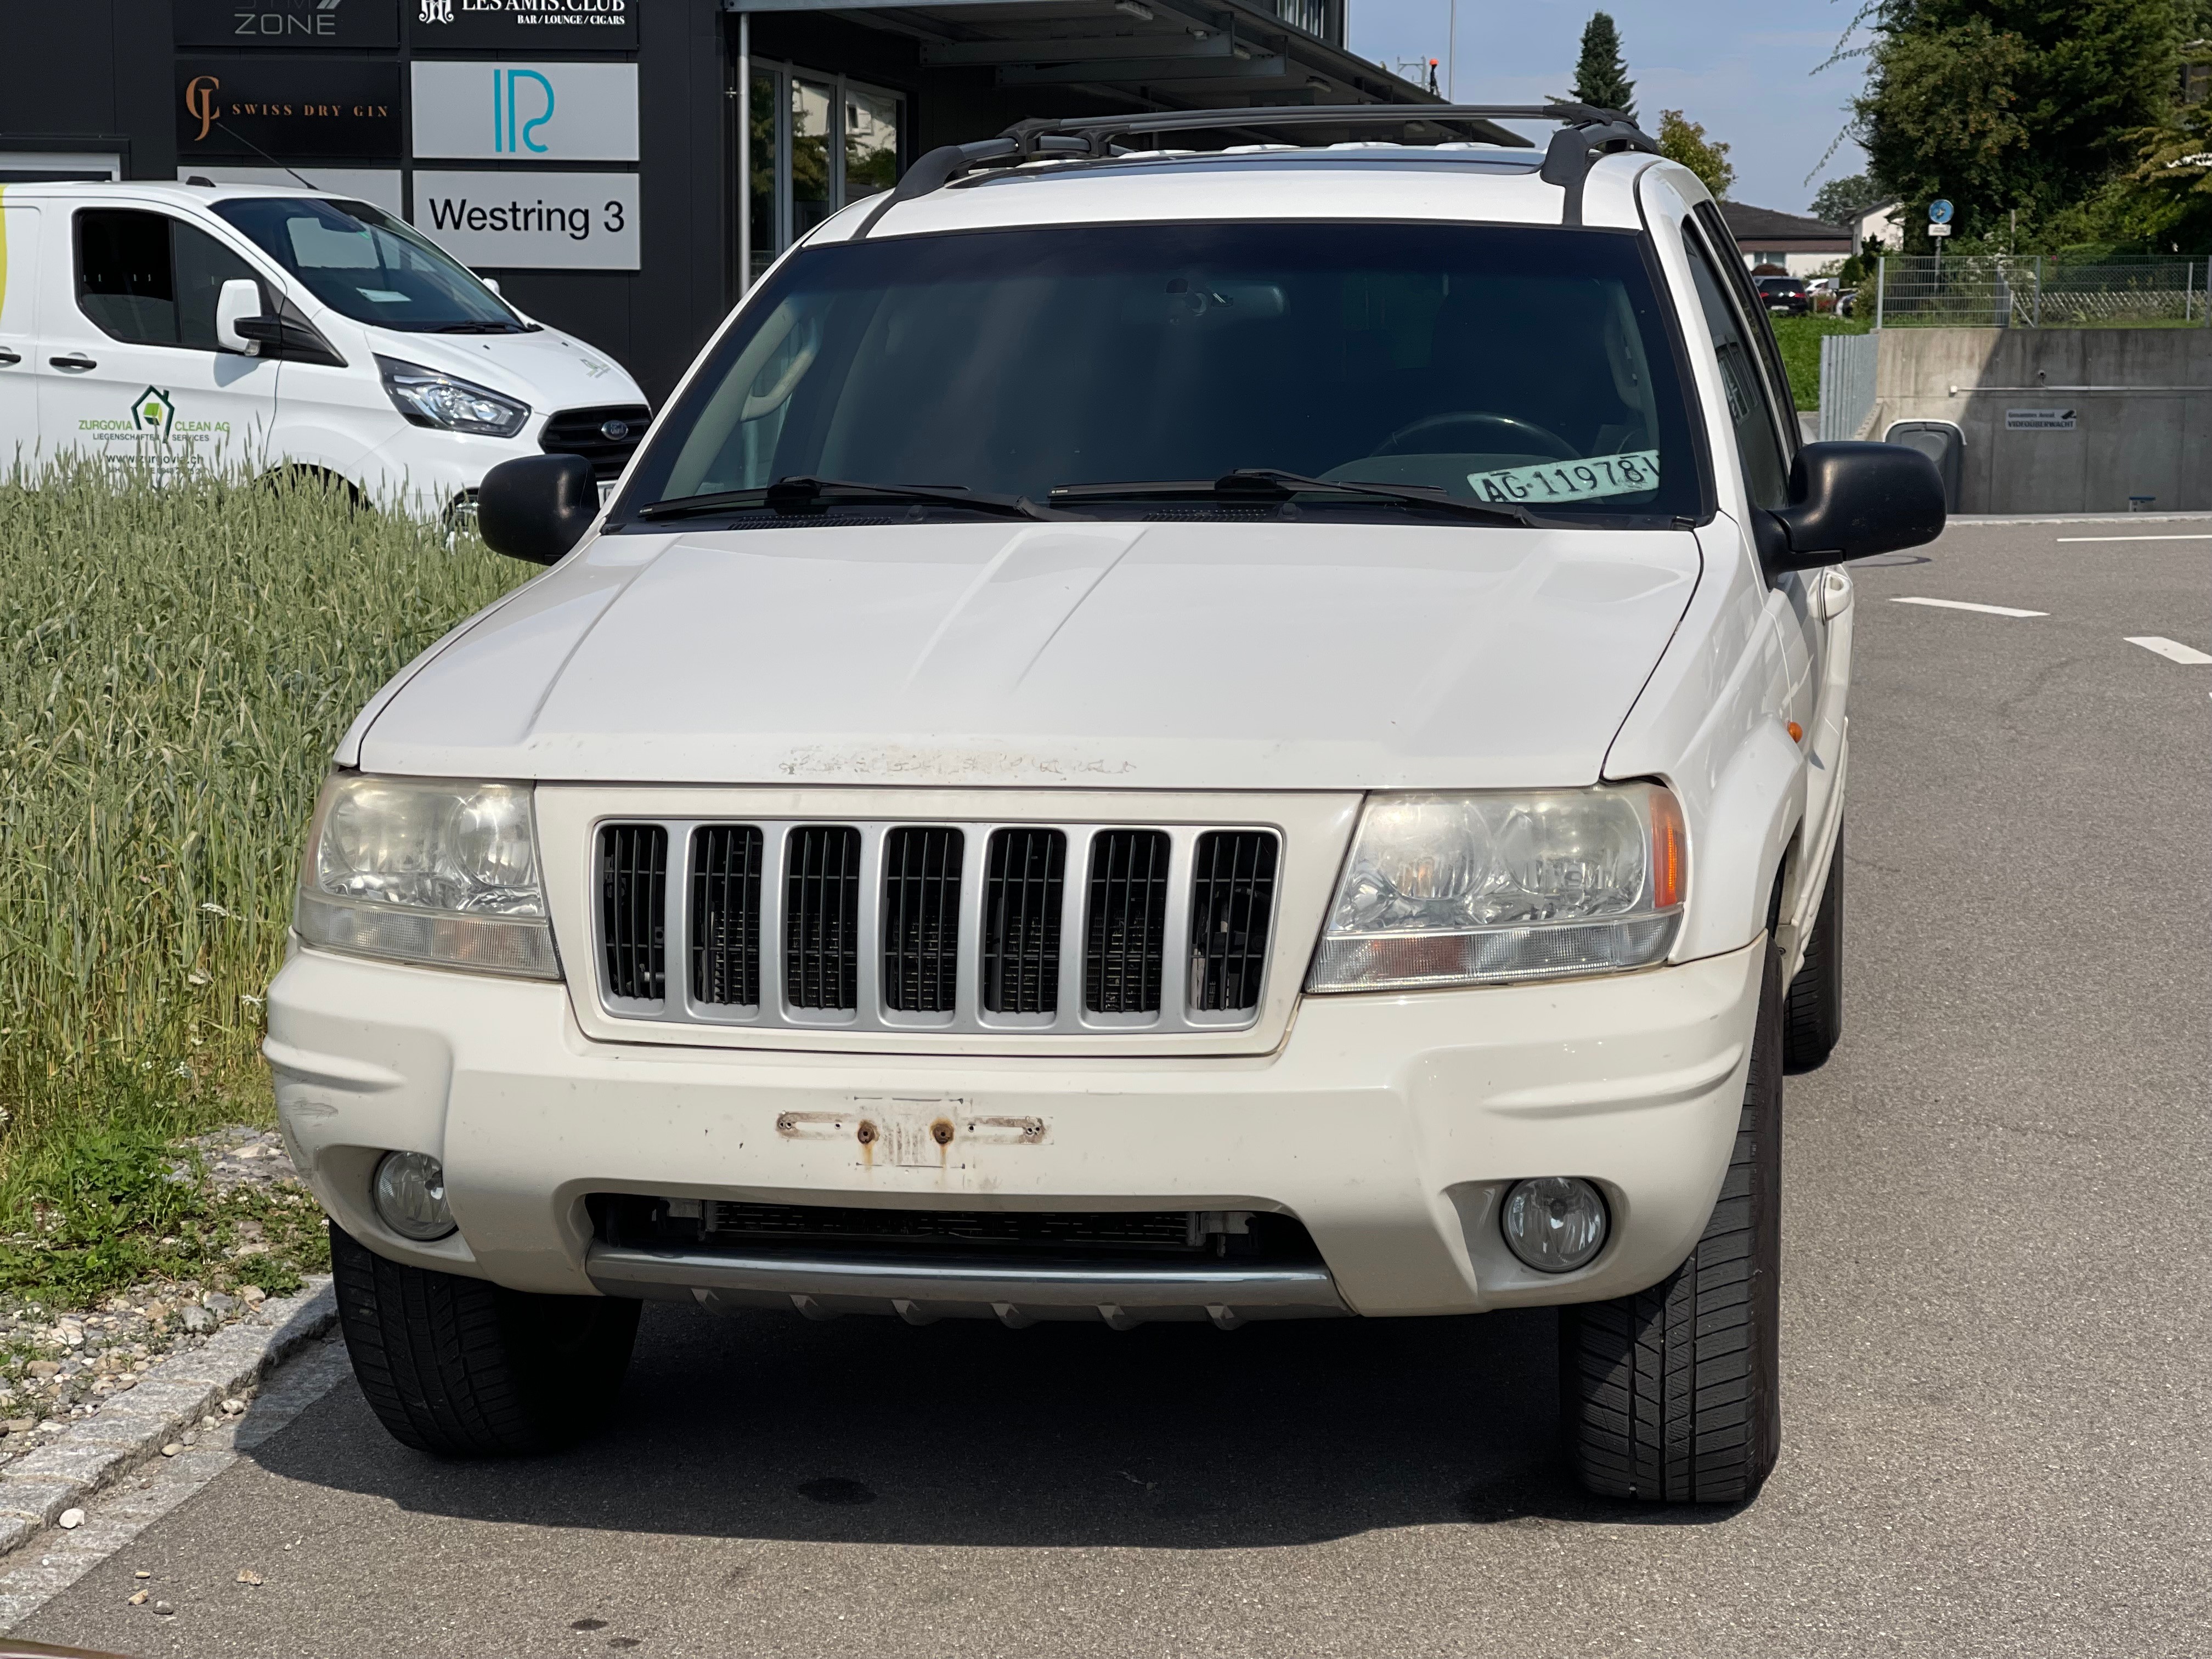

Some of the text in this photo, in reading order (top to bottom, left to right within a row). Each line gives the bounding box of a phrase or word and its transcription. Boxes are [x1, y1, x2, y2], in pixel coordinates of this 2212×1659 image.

[462, 0, 625, 11] LES AMIS.CLUB
[234, 13, 336, 35] ZONE
[232, 104, 388, 117] SWISS DRY GIN
[429, 198, 624, 240] Westring 3
[78, 420, 230, 432] ZURGOVIA CLEAN AG
